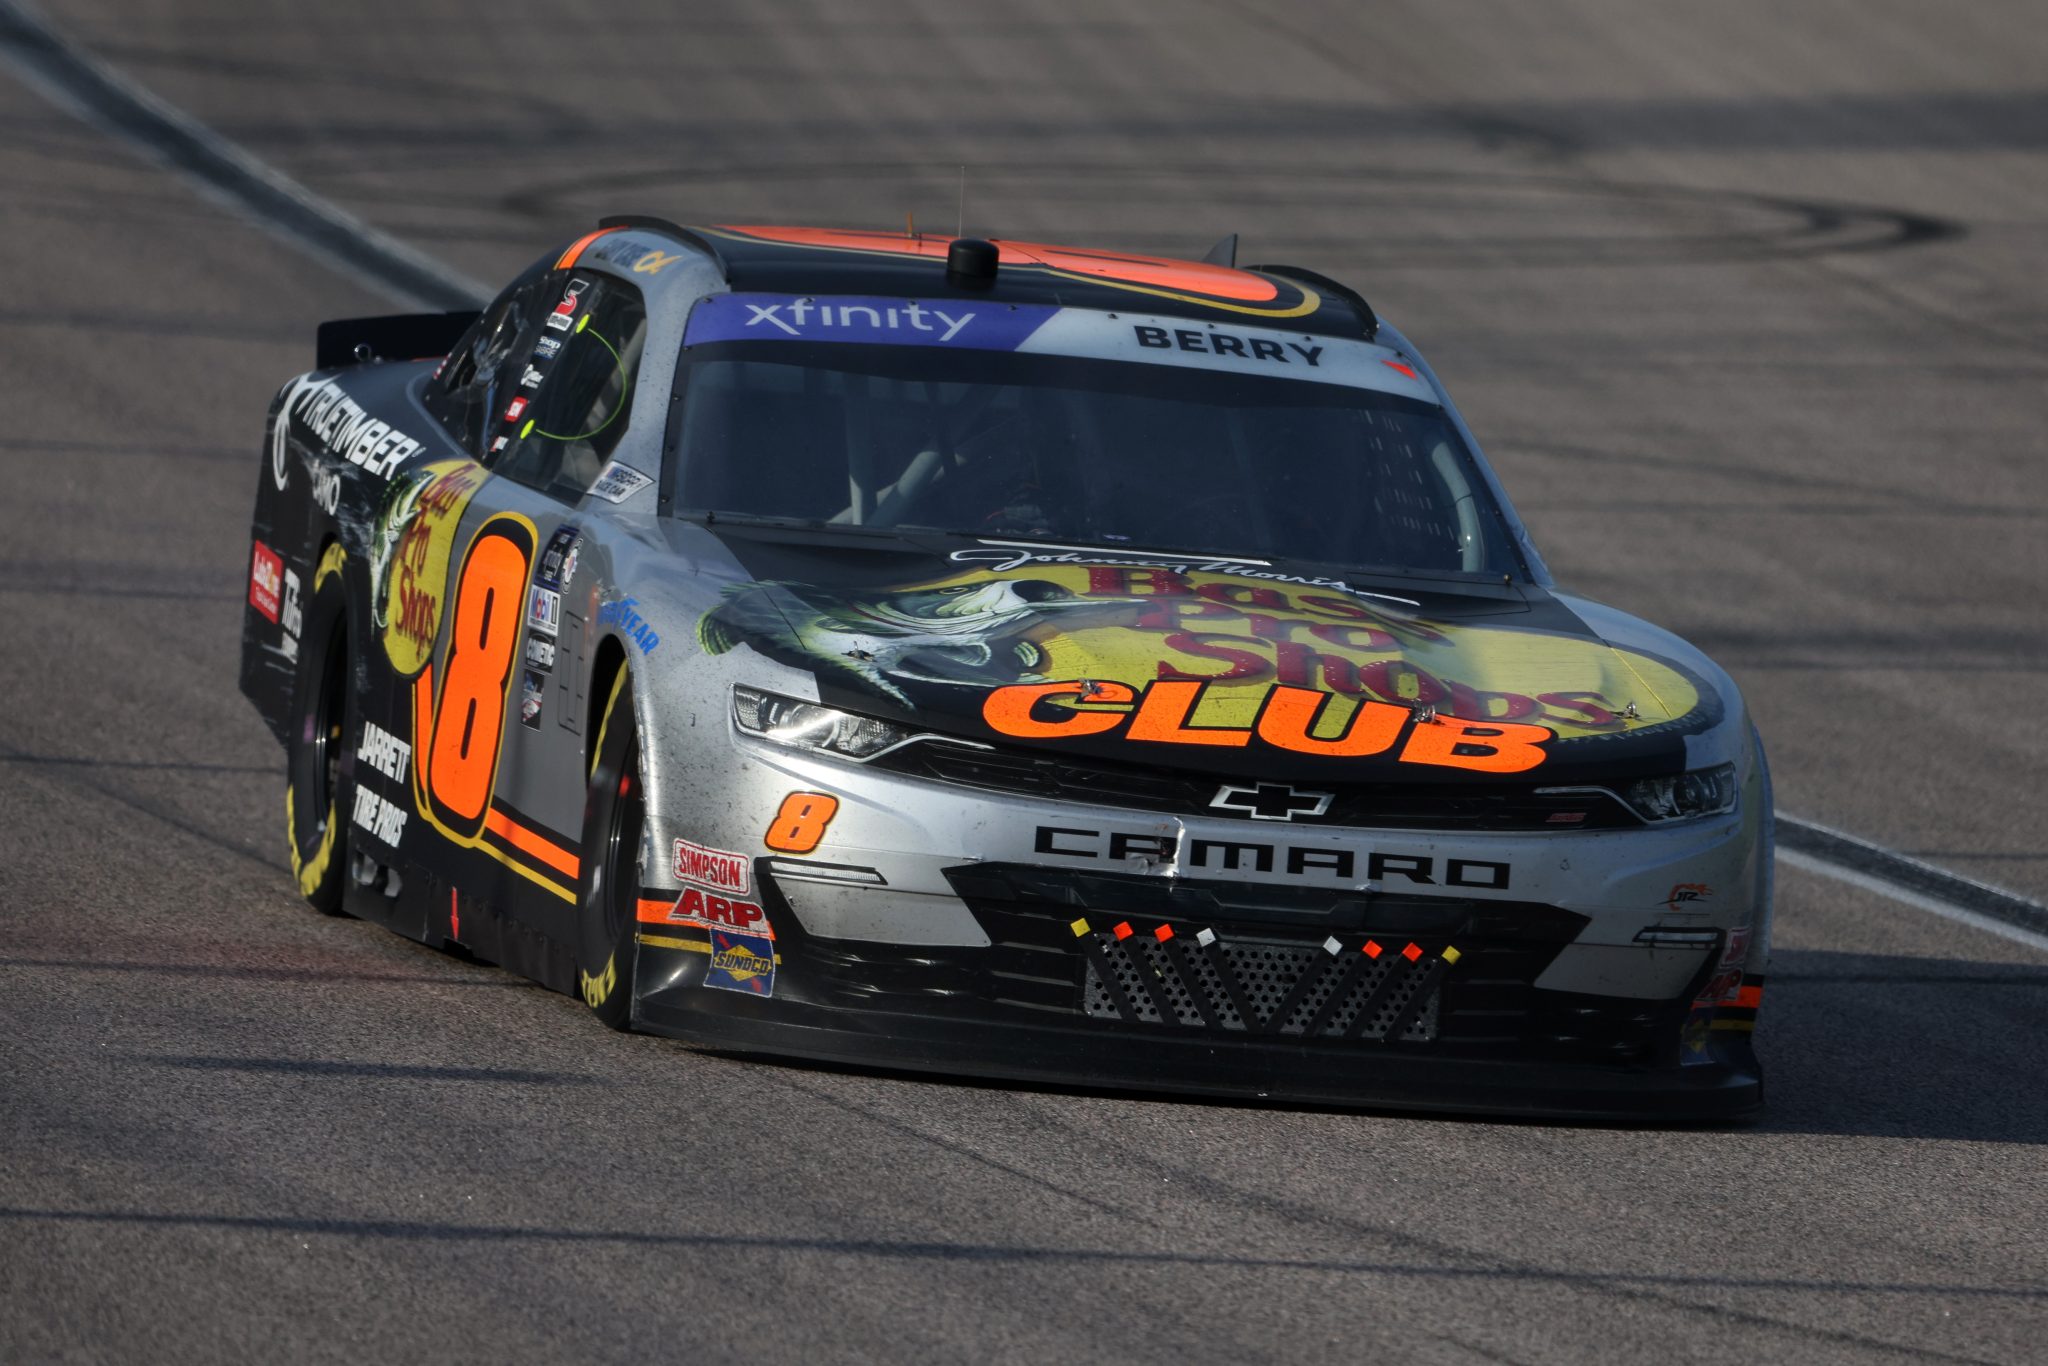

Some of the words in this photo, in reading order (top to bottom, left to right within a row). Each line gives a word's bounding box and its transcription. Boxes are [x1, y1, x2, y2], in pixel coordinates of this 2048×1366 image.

[745, 297, 976, 342] xfinity
[1133, 325, 1324, 367] BERRY
[949, 548, 1188, 574] Johnny
[1199, 561, 1385, 595] Morris
[1088, 565, 1453, 648] Bass
[1136, 598, 1399, 652] Pro
[428, 532, 529, 821] 8
[1156, 631, 1627, 731] Shops
[357, 721, 412, 785] JARRETT
[983, 679, 1552, 773] CLUB
[352, 783, 381, 833] TIRE
[373, 798, 408, 848] PROS
[763, 790, 840, 855] 8
[678, 847, 742, 888] SIMPSON
[1034, 825, 1511, 890] CAMARO
[671, 888, 764, 929] ARP
[714, 951, 770, 975] SUNOCO
